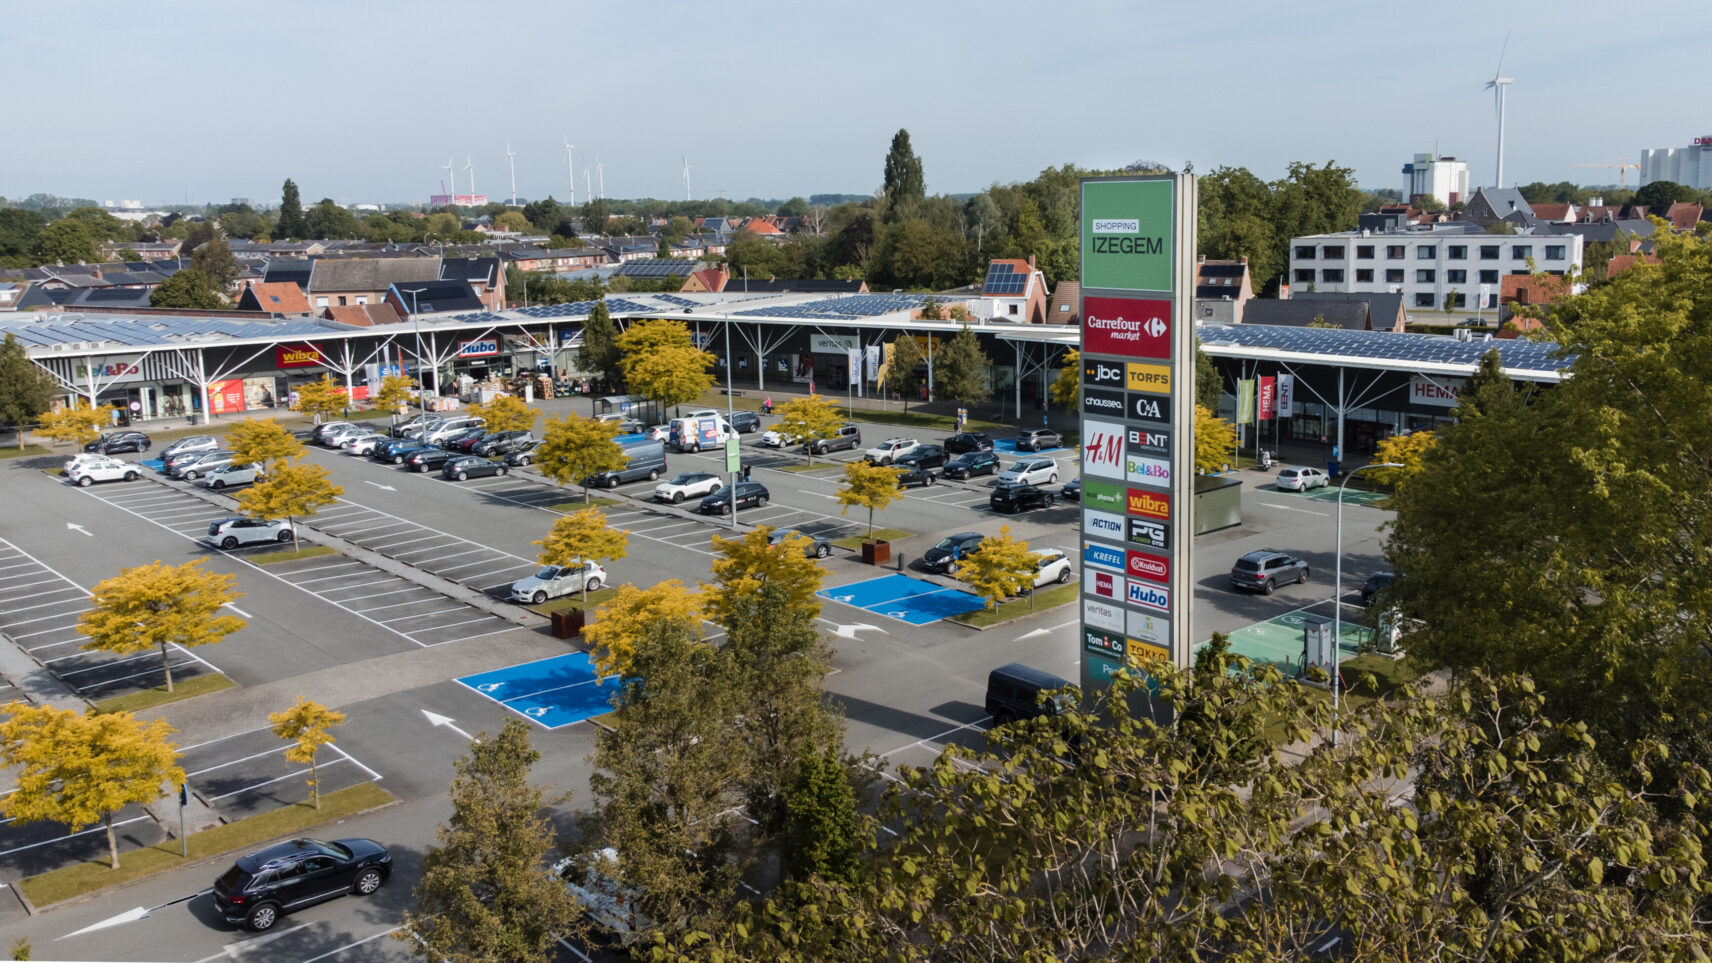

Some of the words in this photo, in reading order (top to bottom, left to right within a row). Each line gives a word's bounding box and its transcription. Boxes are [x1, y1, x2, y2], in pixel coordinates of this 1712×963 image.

[1095, 222, 1137, 231] SHOPPING
[1092, 237, 1163, 254] IZEGEM
[1088, 315, 1141, 331] Carrefour
[1110, 331, 1141, 341] market
[283, 350, 319, 361] wibra
[462, 342, 496, 354] Hubo
[1095, 364, 1120, 381] jbc
[1129, 371, 1169, 384] TORFS
[1262, 384, 1271, 412] HEMA
[1281, 383, 1289, 409] BENT
[1415, 383, 1459, 400] HEMA
[1085, 397, 1123, 409] chaussea
[1136, 399, 1161, 418] C&A
[1129, 430, 1168, 447] BENT
[1085, 432, 1123, 468] H&M
[1128, 460, 1170, 479] Bel&Bo
[1129, 495, 1169, 513] wibra
[1092, 518, 1122, 532] ACTION
[1139, 561, 1164, 573] Kruidvat
[1096, 581, 1113, 589] HEMA
[1130, 585, 1167, 606] Hubo
[1087, 604, 1112, 618] veritas
[1086, 633, 1103, 647] Tom
[1112, 640, 1123, 652] Co
